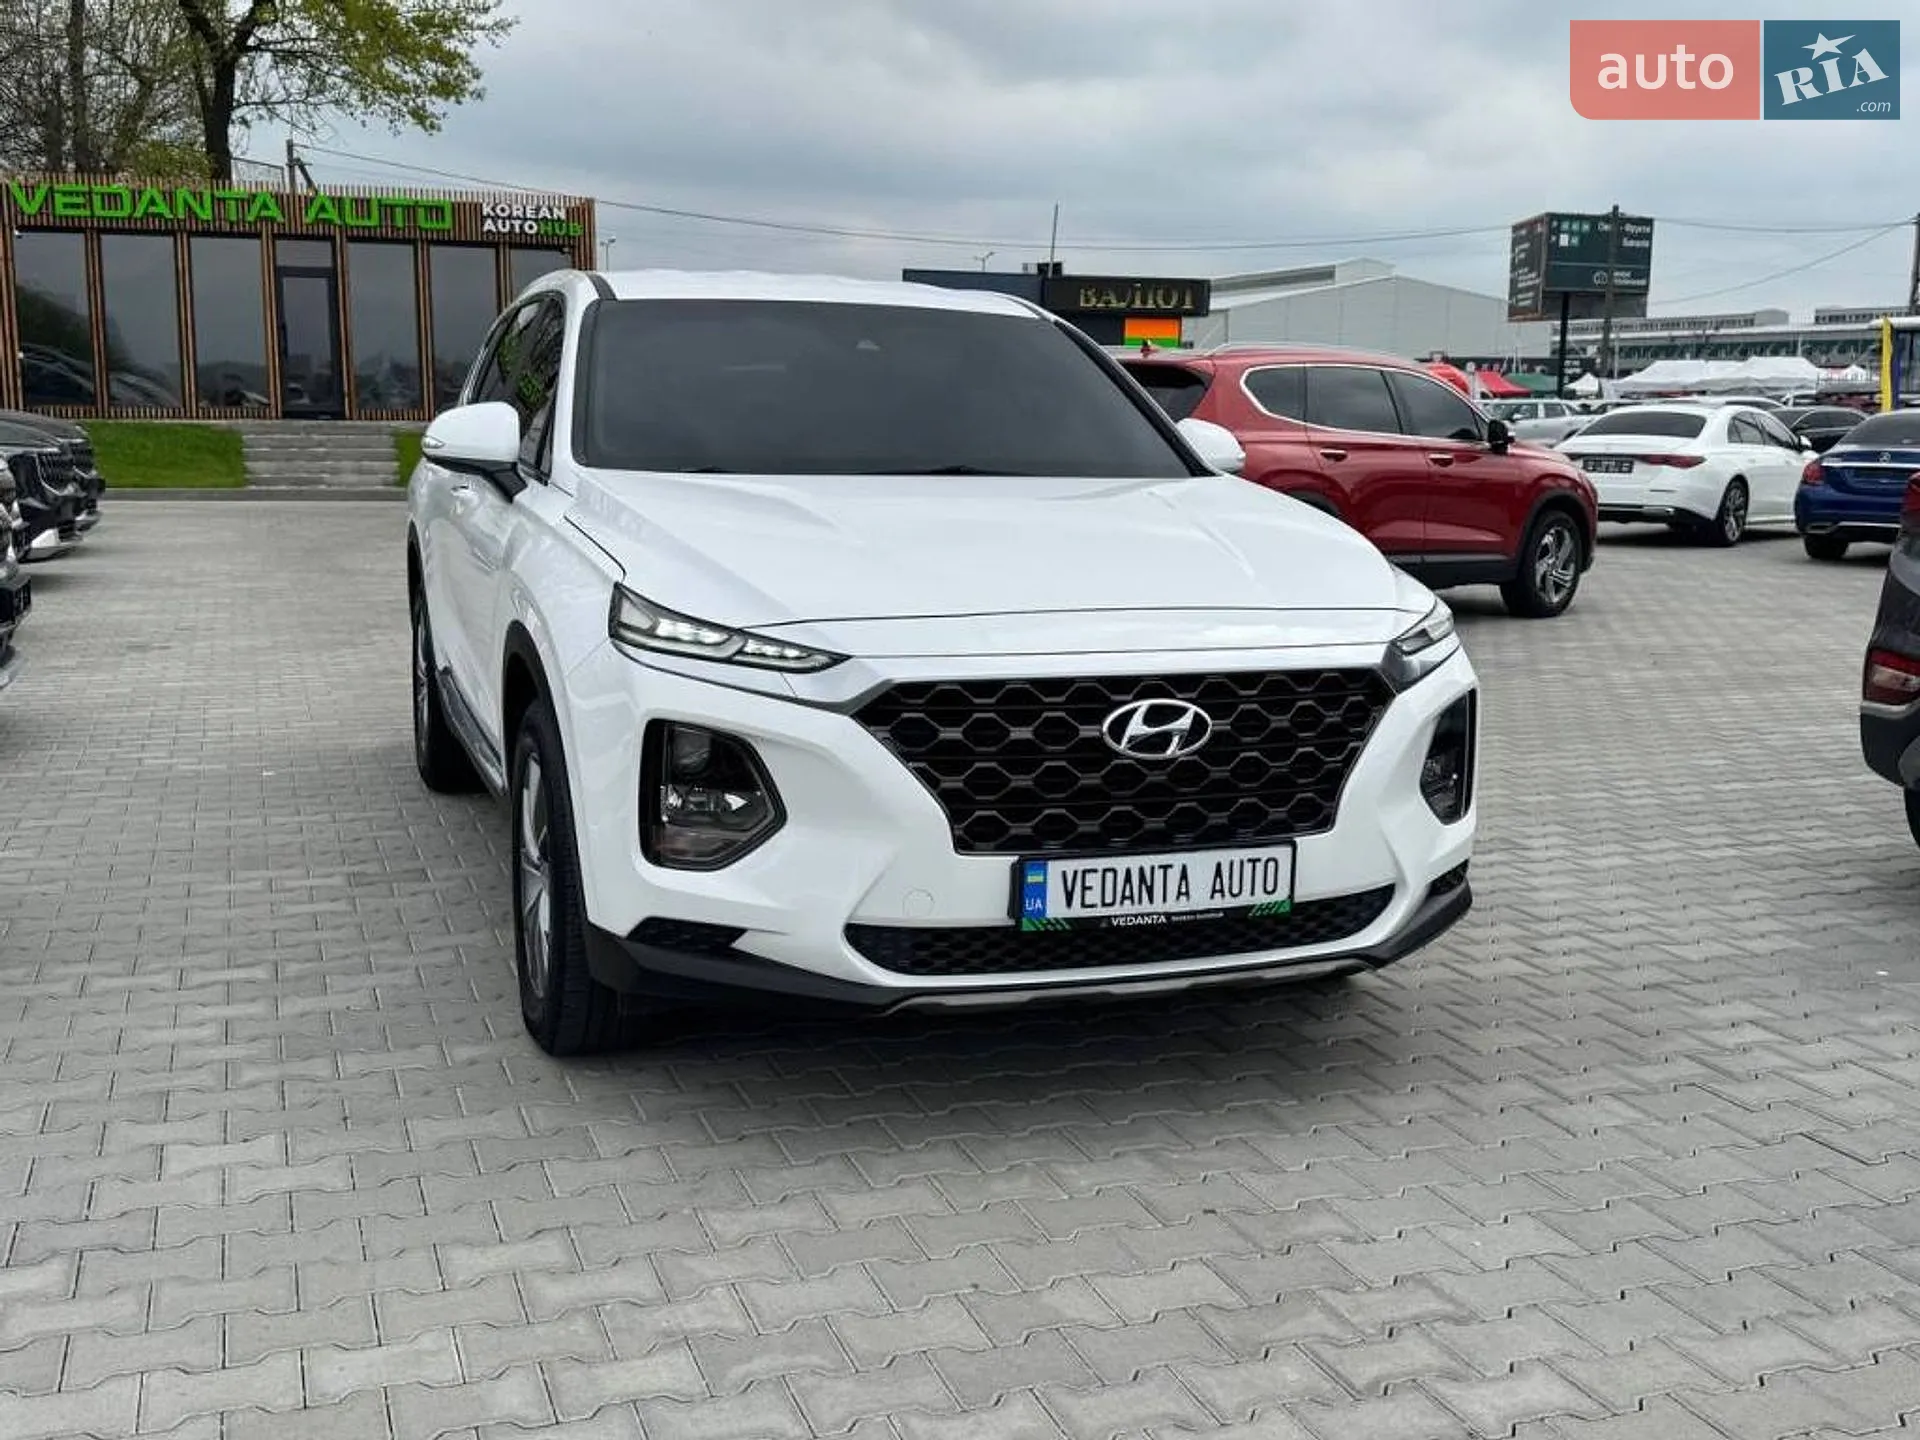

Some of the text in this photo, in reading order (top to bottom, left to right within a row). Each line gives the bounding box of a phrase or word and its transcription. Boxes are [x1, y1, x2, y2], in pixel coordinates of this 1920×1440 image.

[8, 180, 452, 230] VEDANTA AUTO
[482, 201, 566, 219] KOREAN
[1061, 857, 1279, 909] VEDANTA AUTO
[1025, 897, 1044, 912] UA
[1111, 915, 1168, 926] VEDANTA
